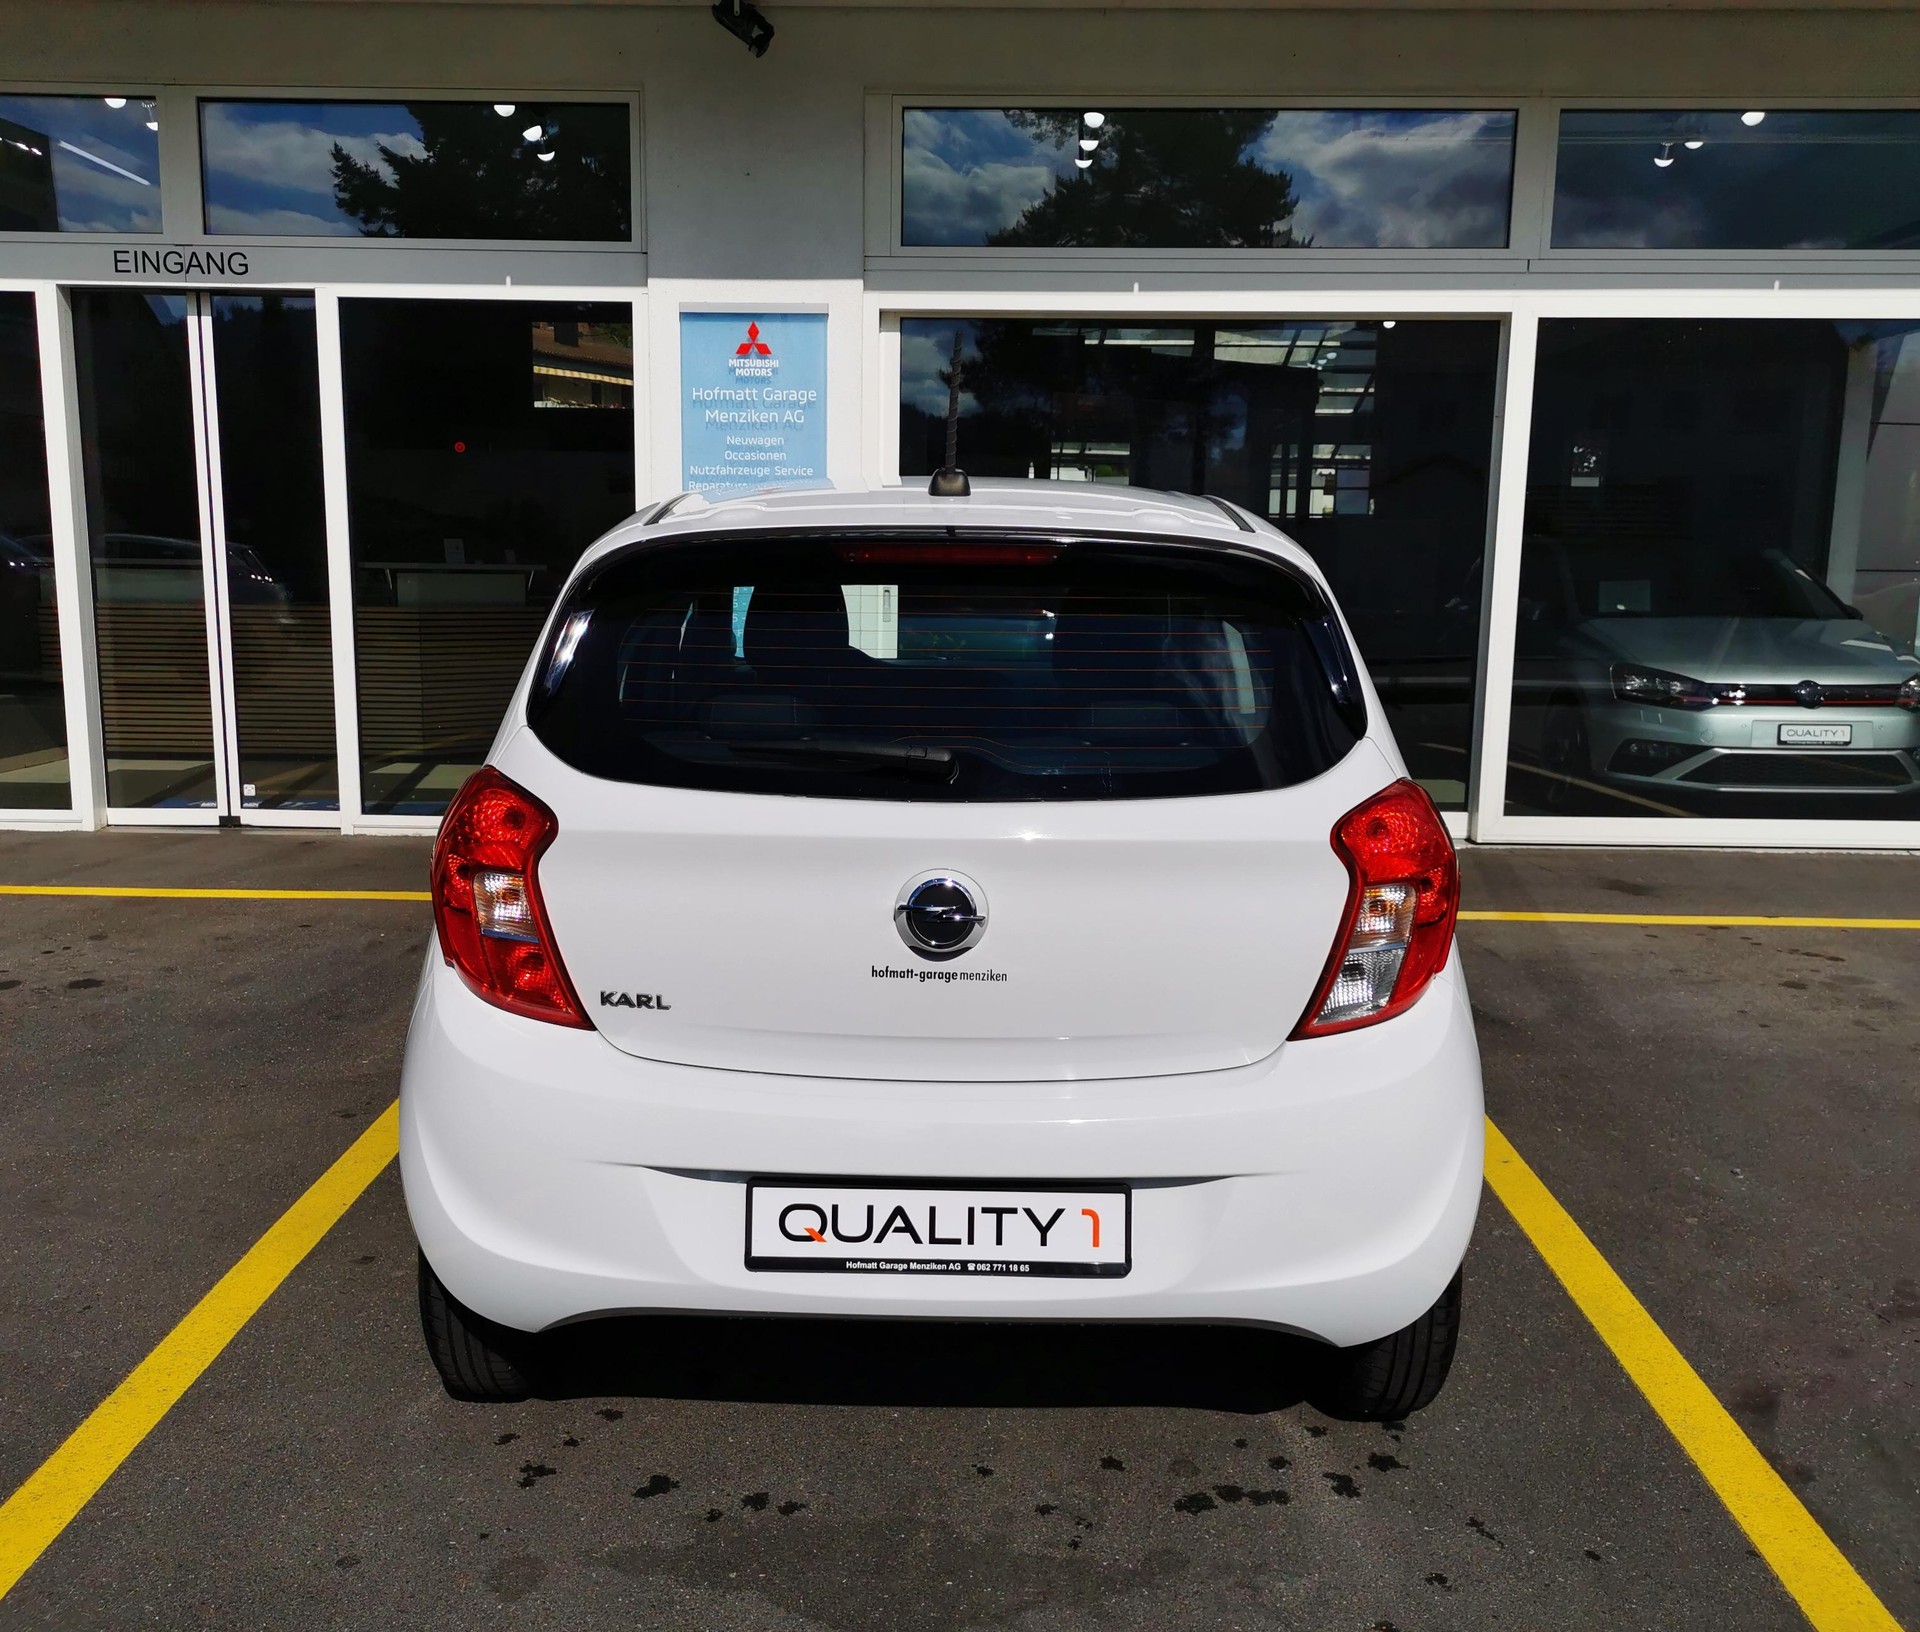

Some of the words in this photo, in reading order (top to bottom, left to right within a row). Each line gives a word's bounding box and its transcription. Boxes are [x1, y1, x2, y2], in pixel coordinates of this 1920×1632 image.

[113, 250, 249, 276] EINGANG
[728, 358, 779, 368] MITSUBISHI
[735, 368, 773, 377] MOTORS
[692, 386, 758, 401] Hofmatt
[762, 387, 817, 404] Garage
[705, 409, 779, 423] Menziken
[783, 410, 805, 423] AG
[726, 435, 785, 447] Neuwagen
[724, 450, 787, 461] Occasionen
[689, 465, 771, 477] Nutzfahrzeuge
[774, 466, 814, 476] Service
[871, 965, 958, 983] hofmatt-garage
[959, 969, 1008, 982] menziken
[600, 990, 672, 1010] KARL
[778, 1203, 1066, 1247] QUALITY
[1081, 1208, 1101, 1248] 1
[846, 1261, 878, 1270] Hofmatt
[879, 1261, 908, 1271] Garage
[909, 1262, 947, 1271] Menziken
[948, 1263, 962, 1271] AG
[976, 1263, 991, 1272] 062
[992, 1264, 1007, 1272] 771
[1009, 1264, 1019, 1272] 18
[1020, 1265, 1030, 1273] 65
